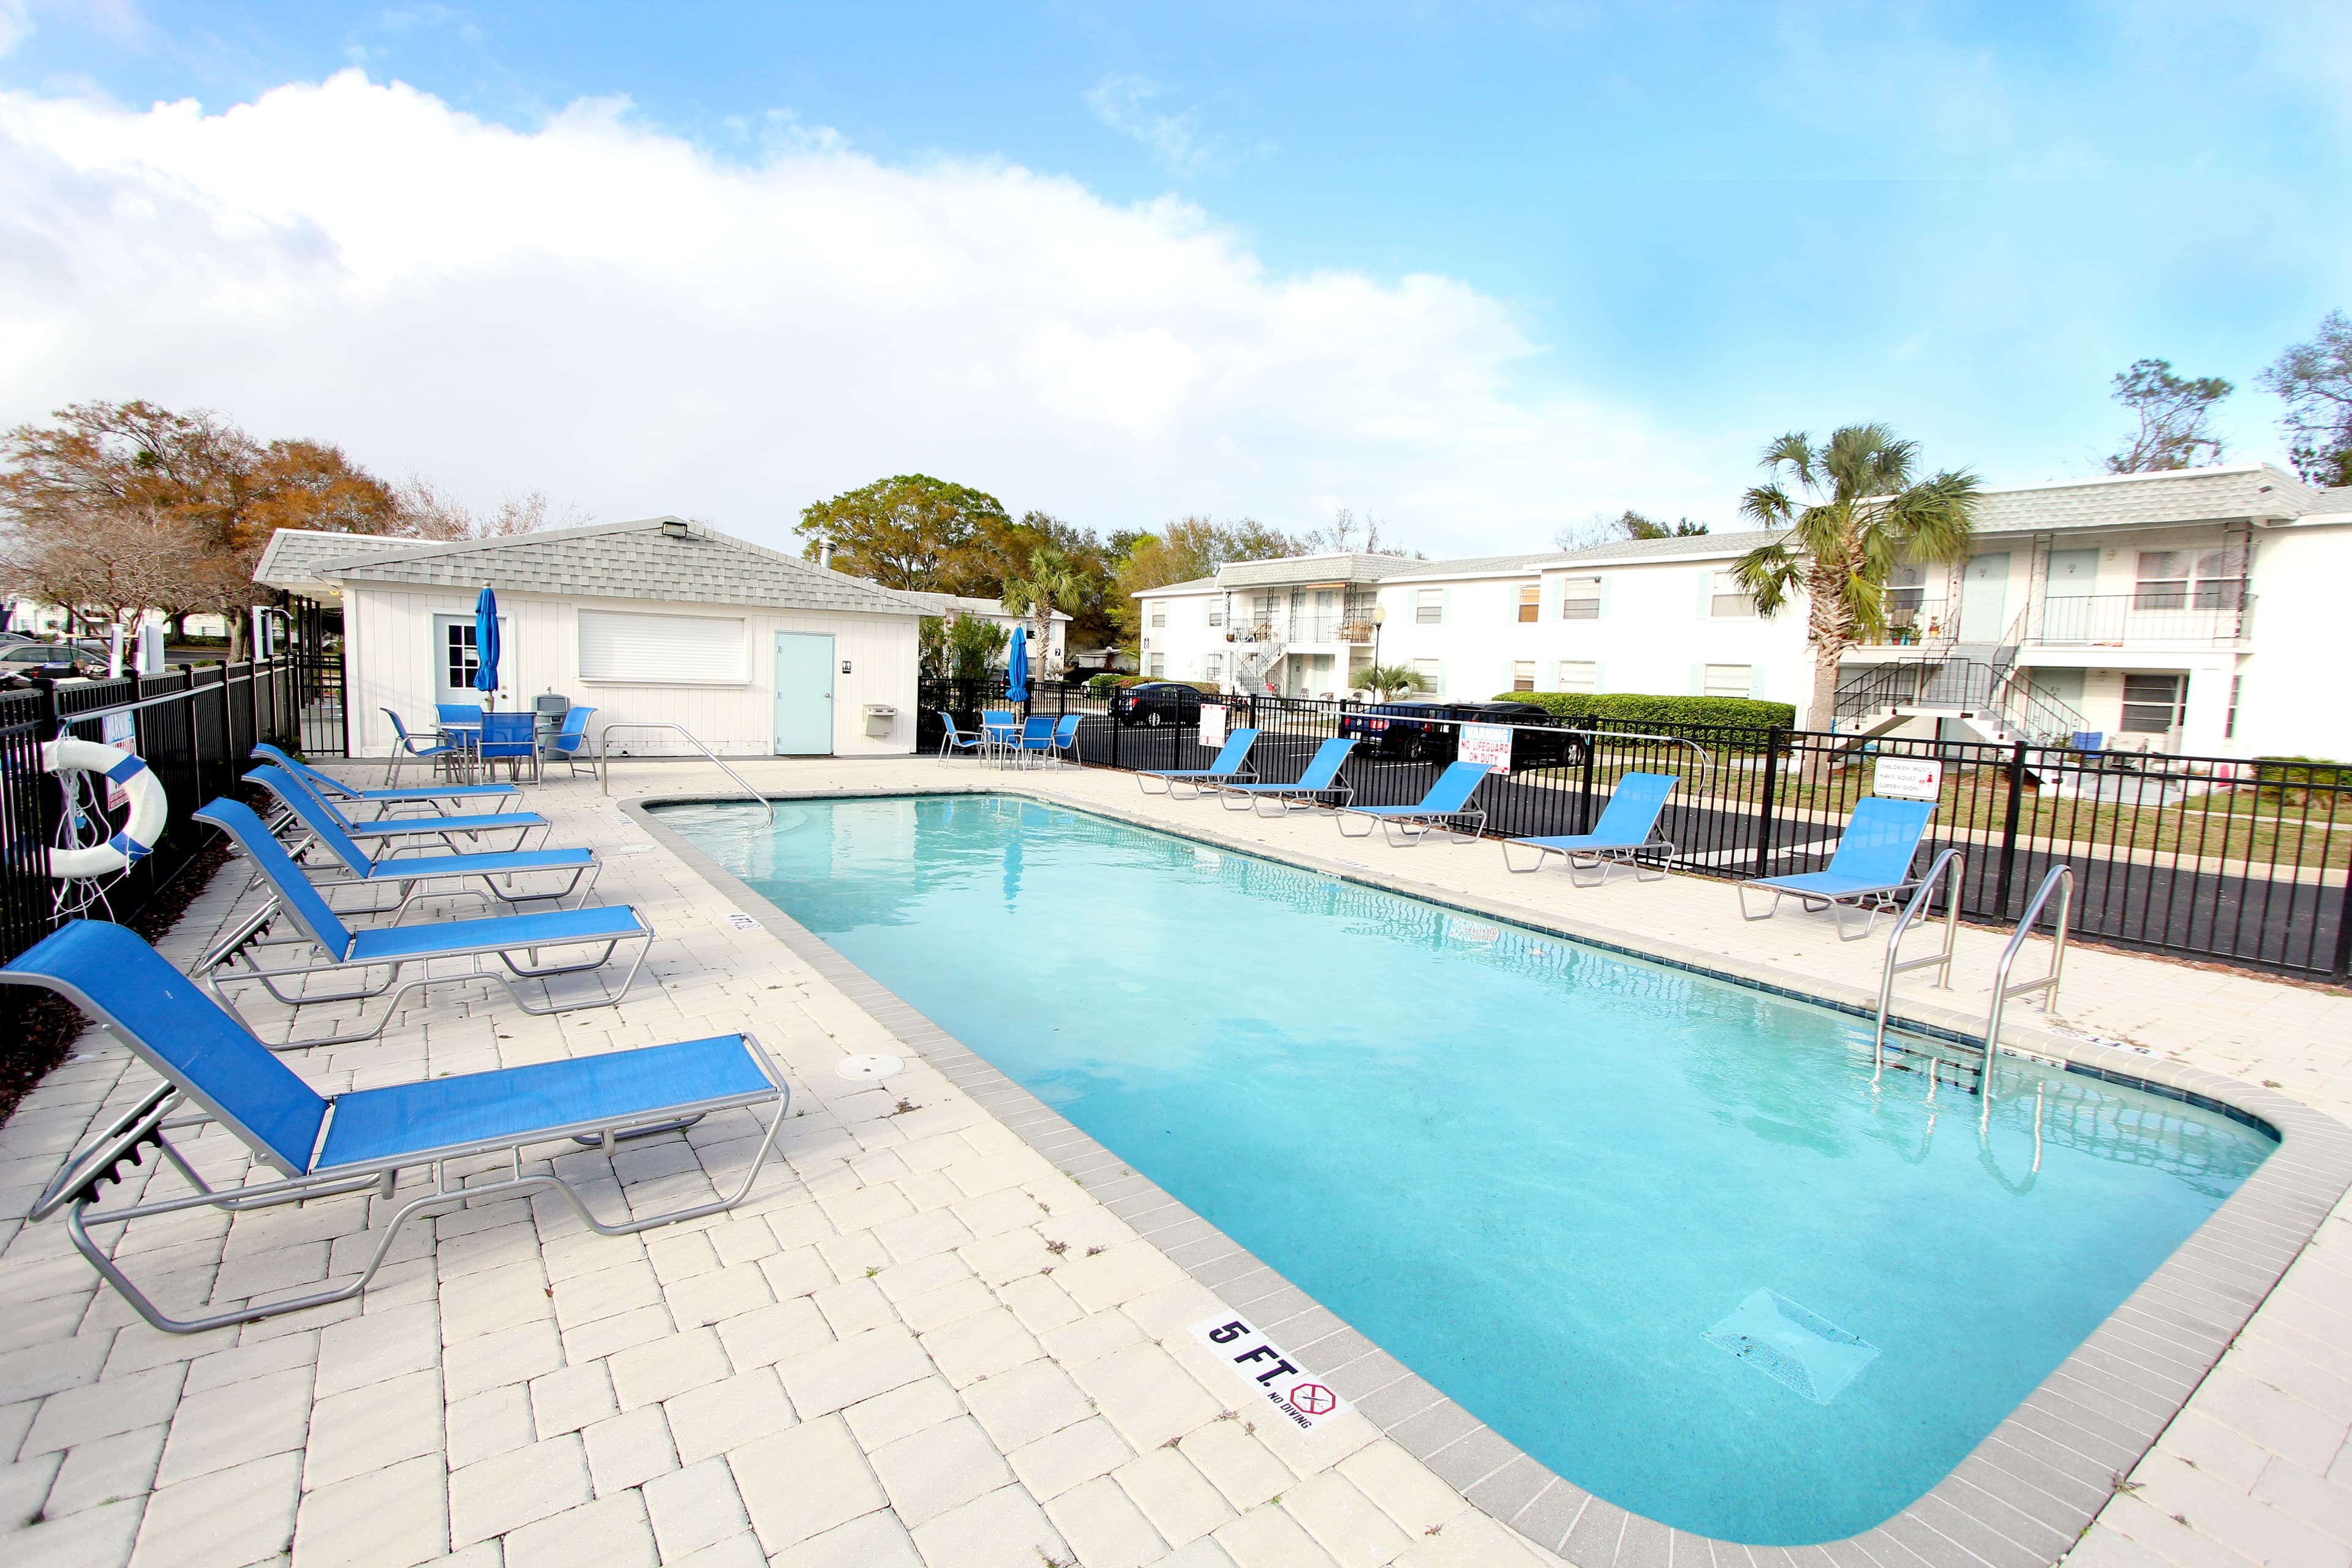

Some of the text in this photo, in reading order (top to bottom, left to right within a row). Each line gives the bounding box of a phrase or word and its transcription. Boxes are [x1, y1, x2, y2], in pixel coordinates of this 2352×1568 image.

[1464, 725, 1509, 742] WARNING
[1461, 740, 1509, 754] NO LIFEGUARD
[1469, 752, 1498, 764] ON DUTY
[1878, 782, 1919, 791] SUPERVISION
[1209, 1321, 1299, 1387] 5 FT.
[1267, 1392, 1313, 1429] NO DIVING
